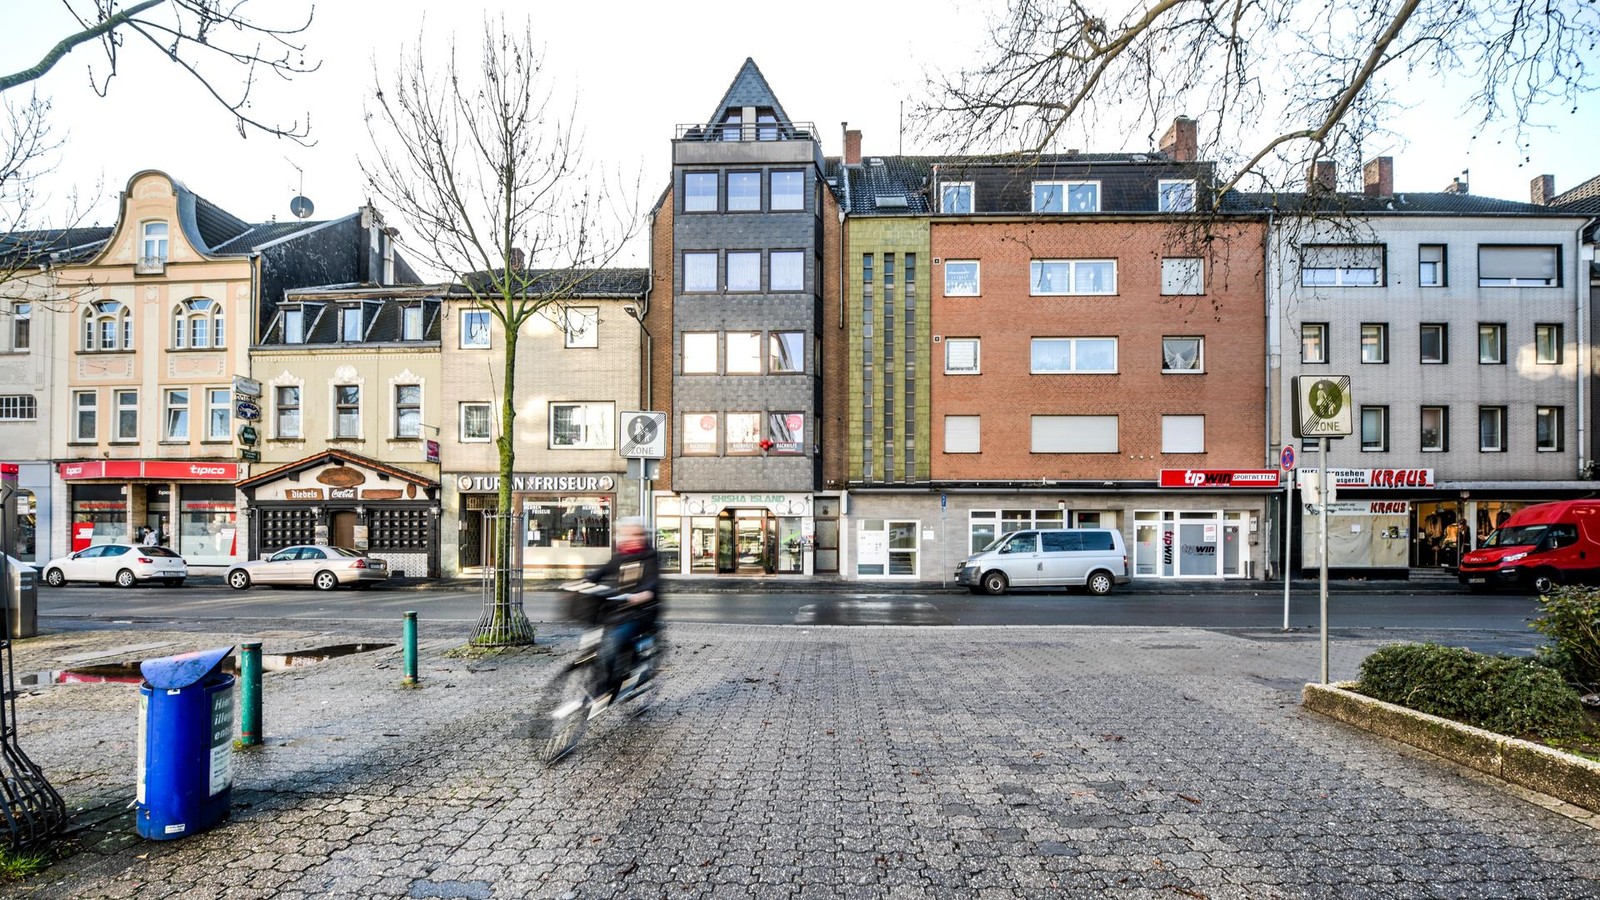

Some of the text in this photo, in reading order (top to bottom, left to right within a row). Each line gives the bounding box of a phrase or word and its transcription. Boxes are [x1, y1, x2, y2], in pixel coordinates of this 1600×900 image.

[1315, 421, 1340, 431] ZONE
[631, 446, 654, 455] ZONE
[190, 465, 225, 475] tipico
[474, 476, 598, 490] TURN FRISEUR
[1184, 469, 1231, 487] tipwin
[1370, 469, 1428, 488] KRAUS
[291, 490, 318, 499] Diebels
[711, 495, 786, 503] SHISHA ISLAND
[1369, 502, 1406, 514] KRAUS
[1163, 530, 1174, 565] tipwin
